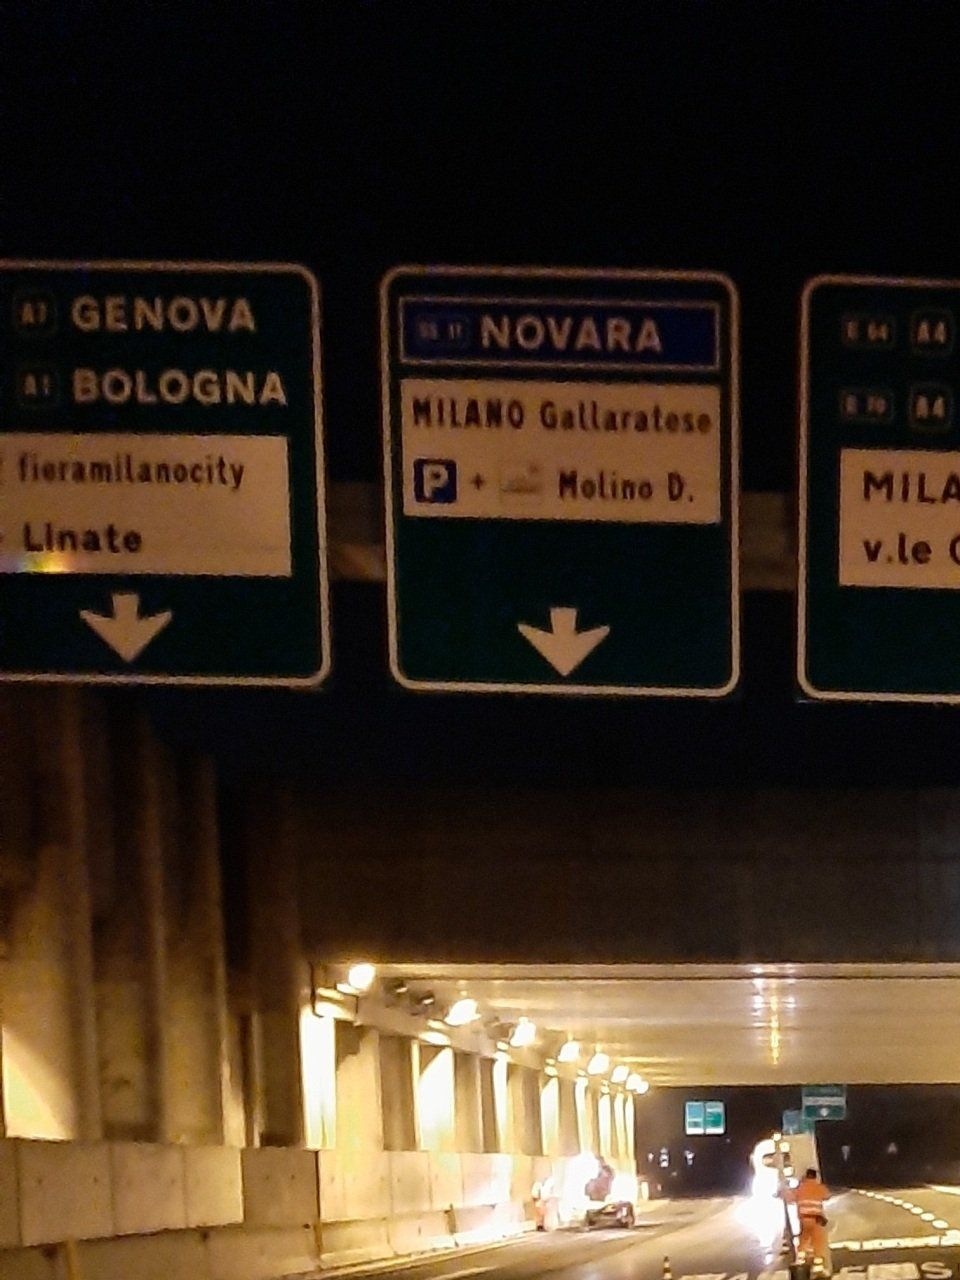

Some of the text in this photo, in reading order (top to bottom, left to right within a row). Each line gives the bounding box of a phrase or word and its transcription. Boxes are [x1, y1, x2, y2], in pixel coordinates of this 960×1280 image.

[71, 296, 257, 332] GENOVA
[481, 313, 664, 353] NOVARA
[73, 368, 288, 405] BOLOGNA
[412, 397, 712, 433] MILANO Gallaratese
[18, 453, 245, 489] fieramilanocity
[558, 470, 654, 502] Molino
[667, 473, 696, 503] D.
[24, 523, 143, 553] Linate
[863, 533, 932, 564] v.le
